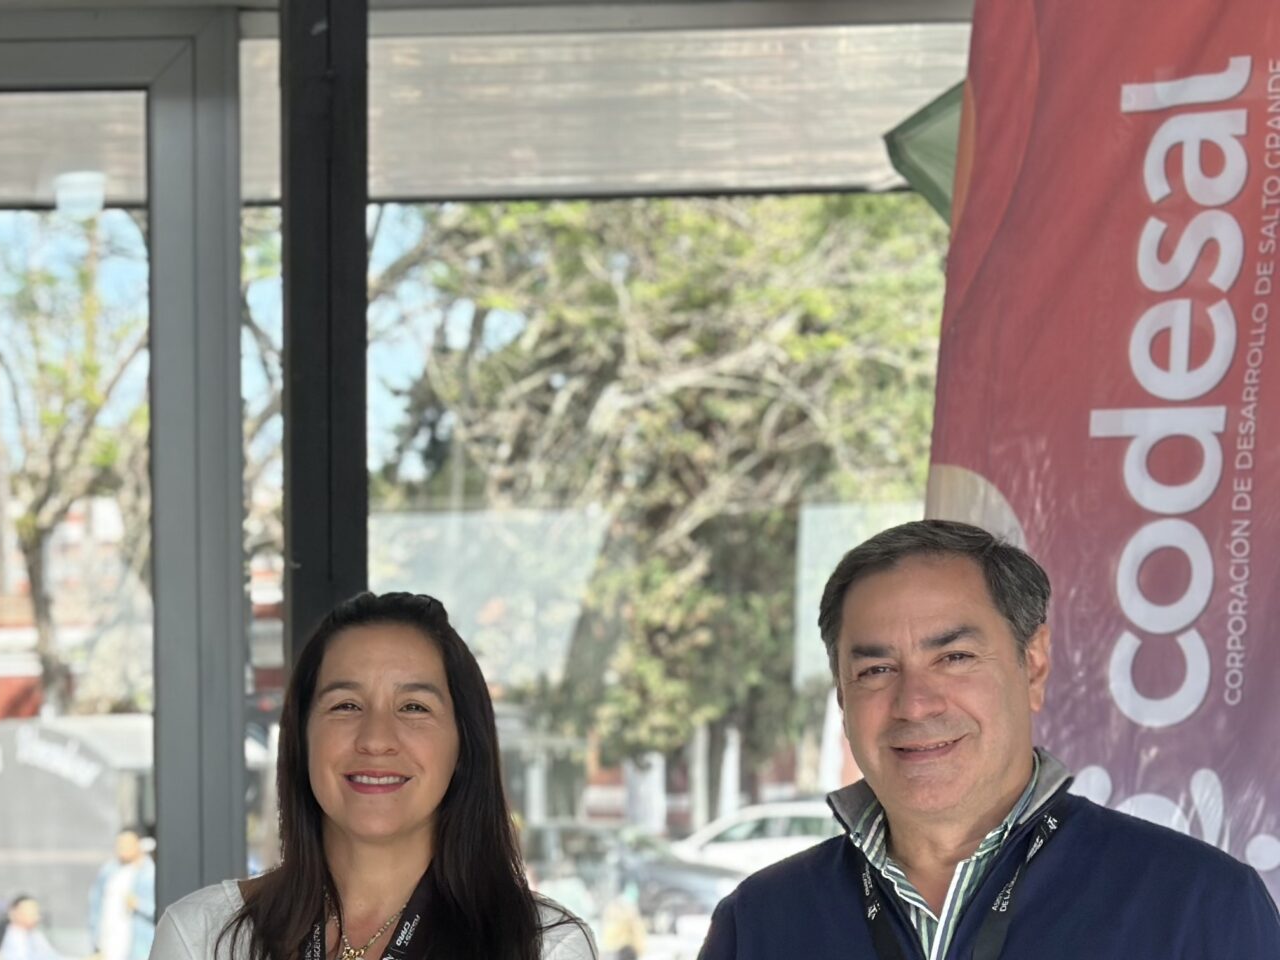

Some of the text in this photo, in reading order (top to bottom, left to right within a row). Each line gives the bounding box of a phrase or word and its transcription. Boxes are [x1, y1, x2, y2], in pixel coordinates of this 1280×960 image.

[1258, 175, 1280, 254] SALTO
[1254, 261, 1275, 296] DE
[1090, 55, 1252, 727] codesal
[1234, 303, 1269, 470] DESARROLLO
[1231, 477, 1251, 512] DE
[1224, 520, 1251, 706] CORPORACIÓN
[394, 920, 411, 947] CARD
